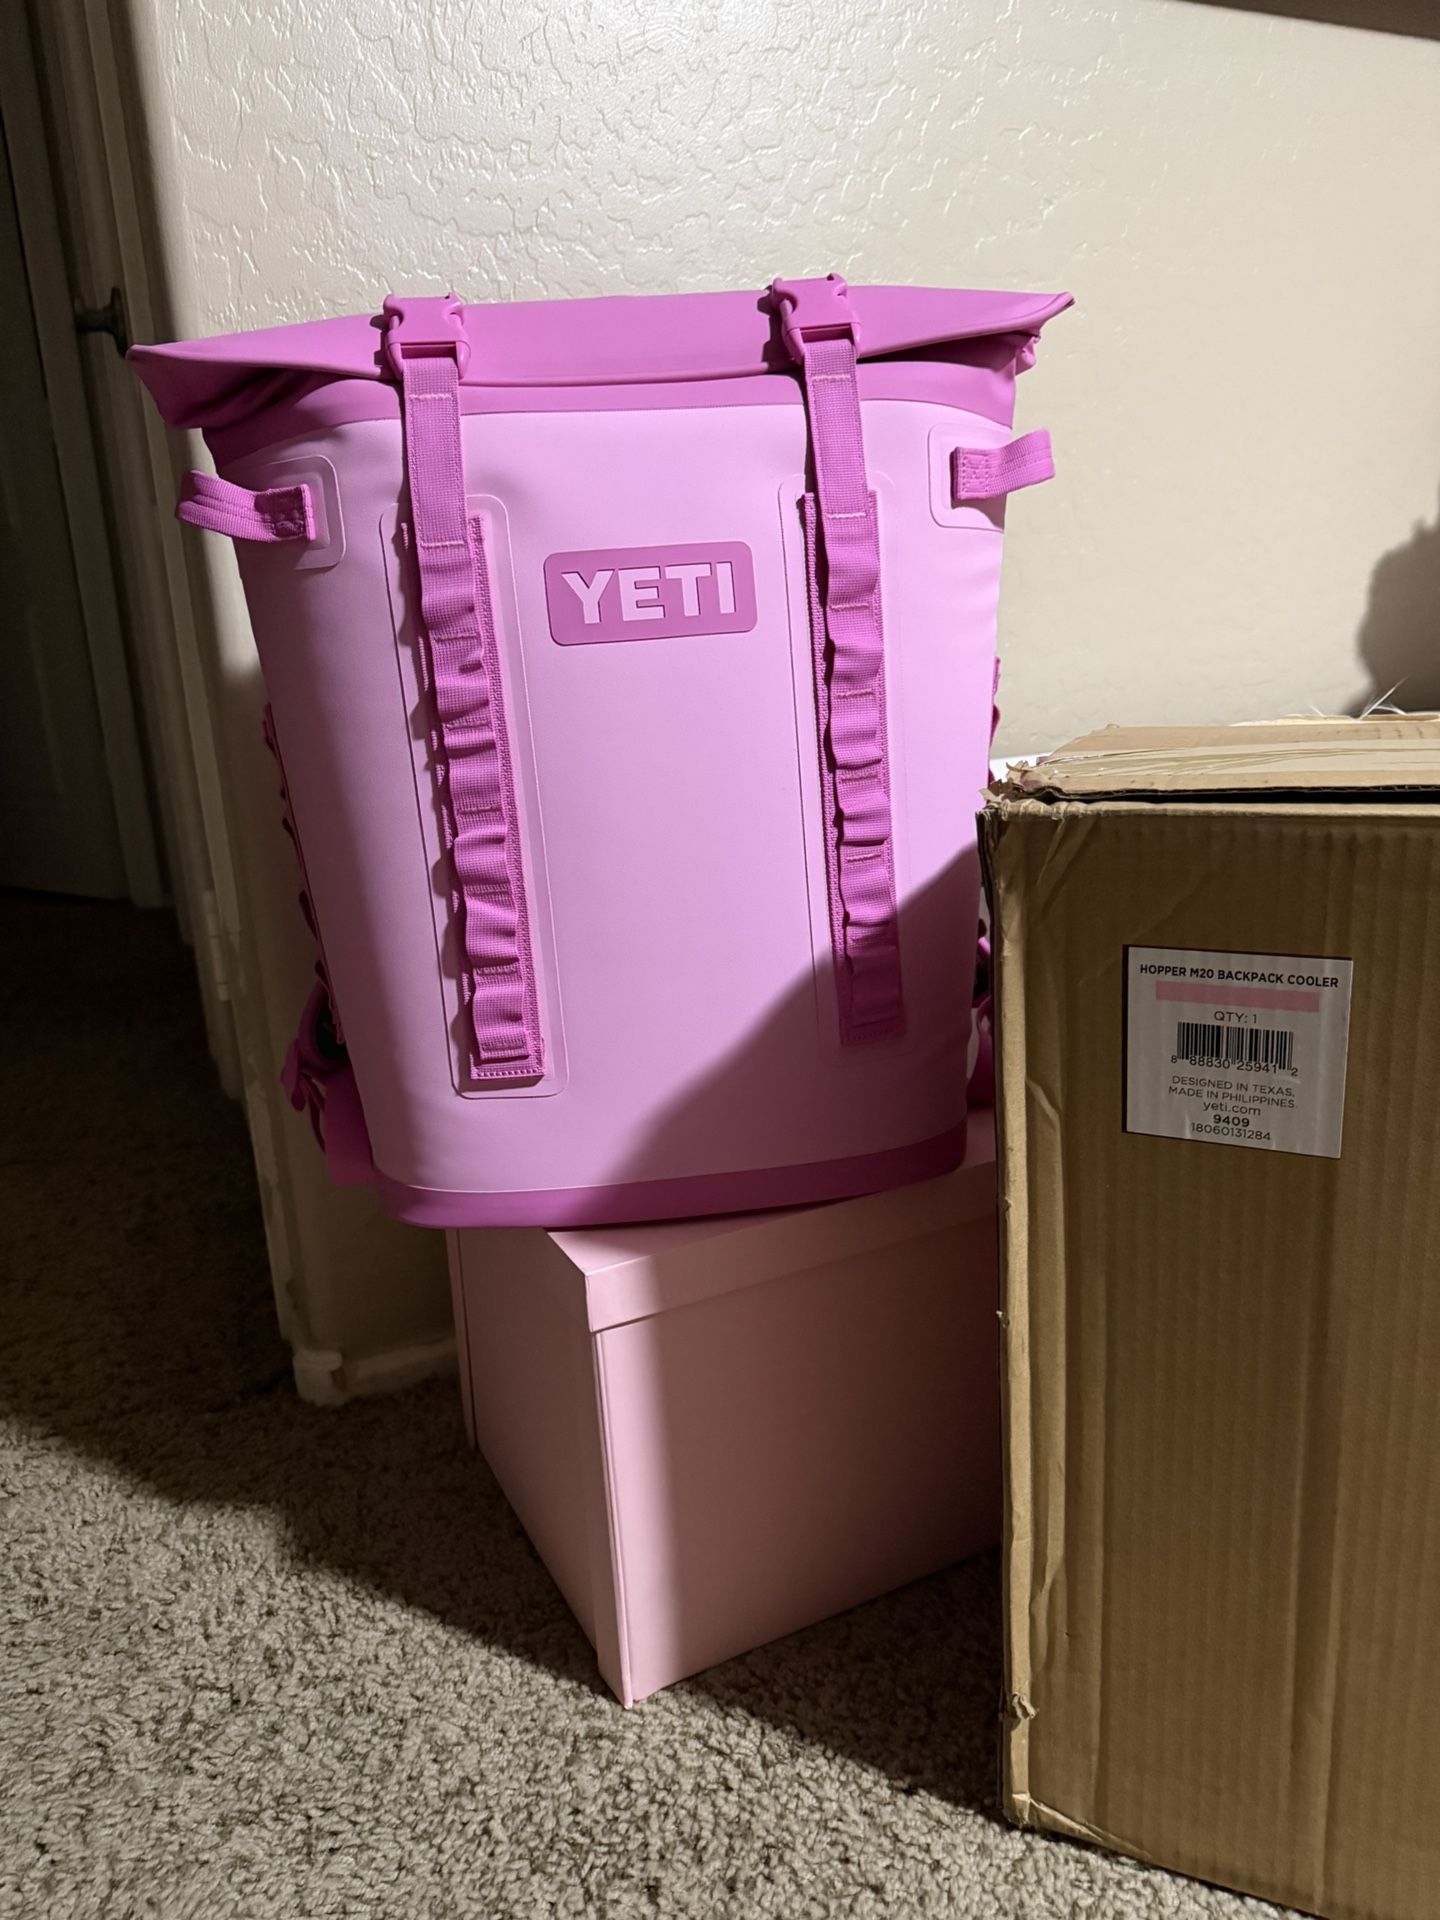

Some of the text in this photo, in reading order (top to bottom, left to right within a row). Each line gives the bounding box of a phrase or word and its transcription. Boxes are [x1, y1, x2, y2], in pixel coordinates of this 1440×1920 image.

[561, 561, 736, 624] YETI
[1140, 964, 1338, 987] HOPPER M20 BACKPACK COOLER
[1214, 1011, 1248, 1023] QTY:
[1171, 1055, 1298, 1076] 8 88830 25941 2
[1172, 1076, 1232, 1090] DESIGNED
[1237, 1083, 1248, 1091] IN
[1169, 1086, 1202, 1098] MADE
[1207, 1090, 1218, 1099] IN
[1203, 1102, 1261, 1116] yeti.com
[1213, 1114, 1249, 1127] 9409
[1191, 1122, 1270, 1141] 18060131284
